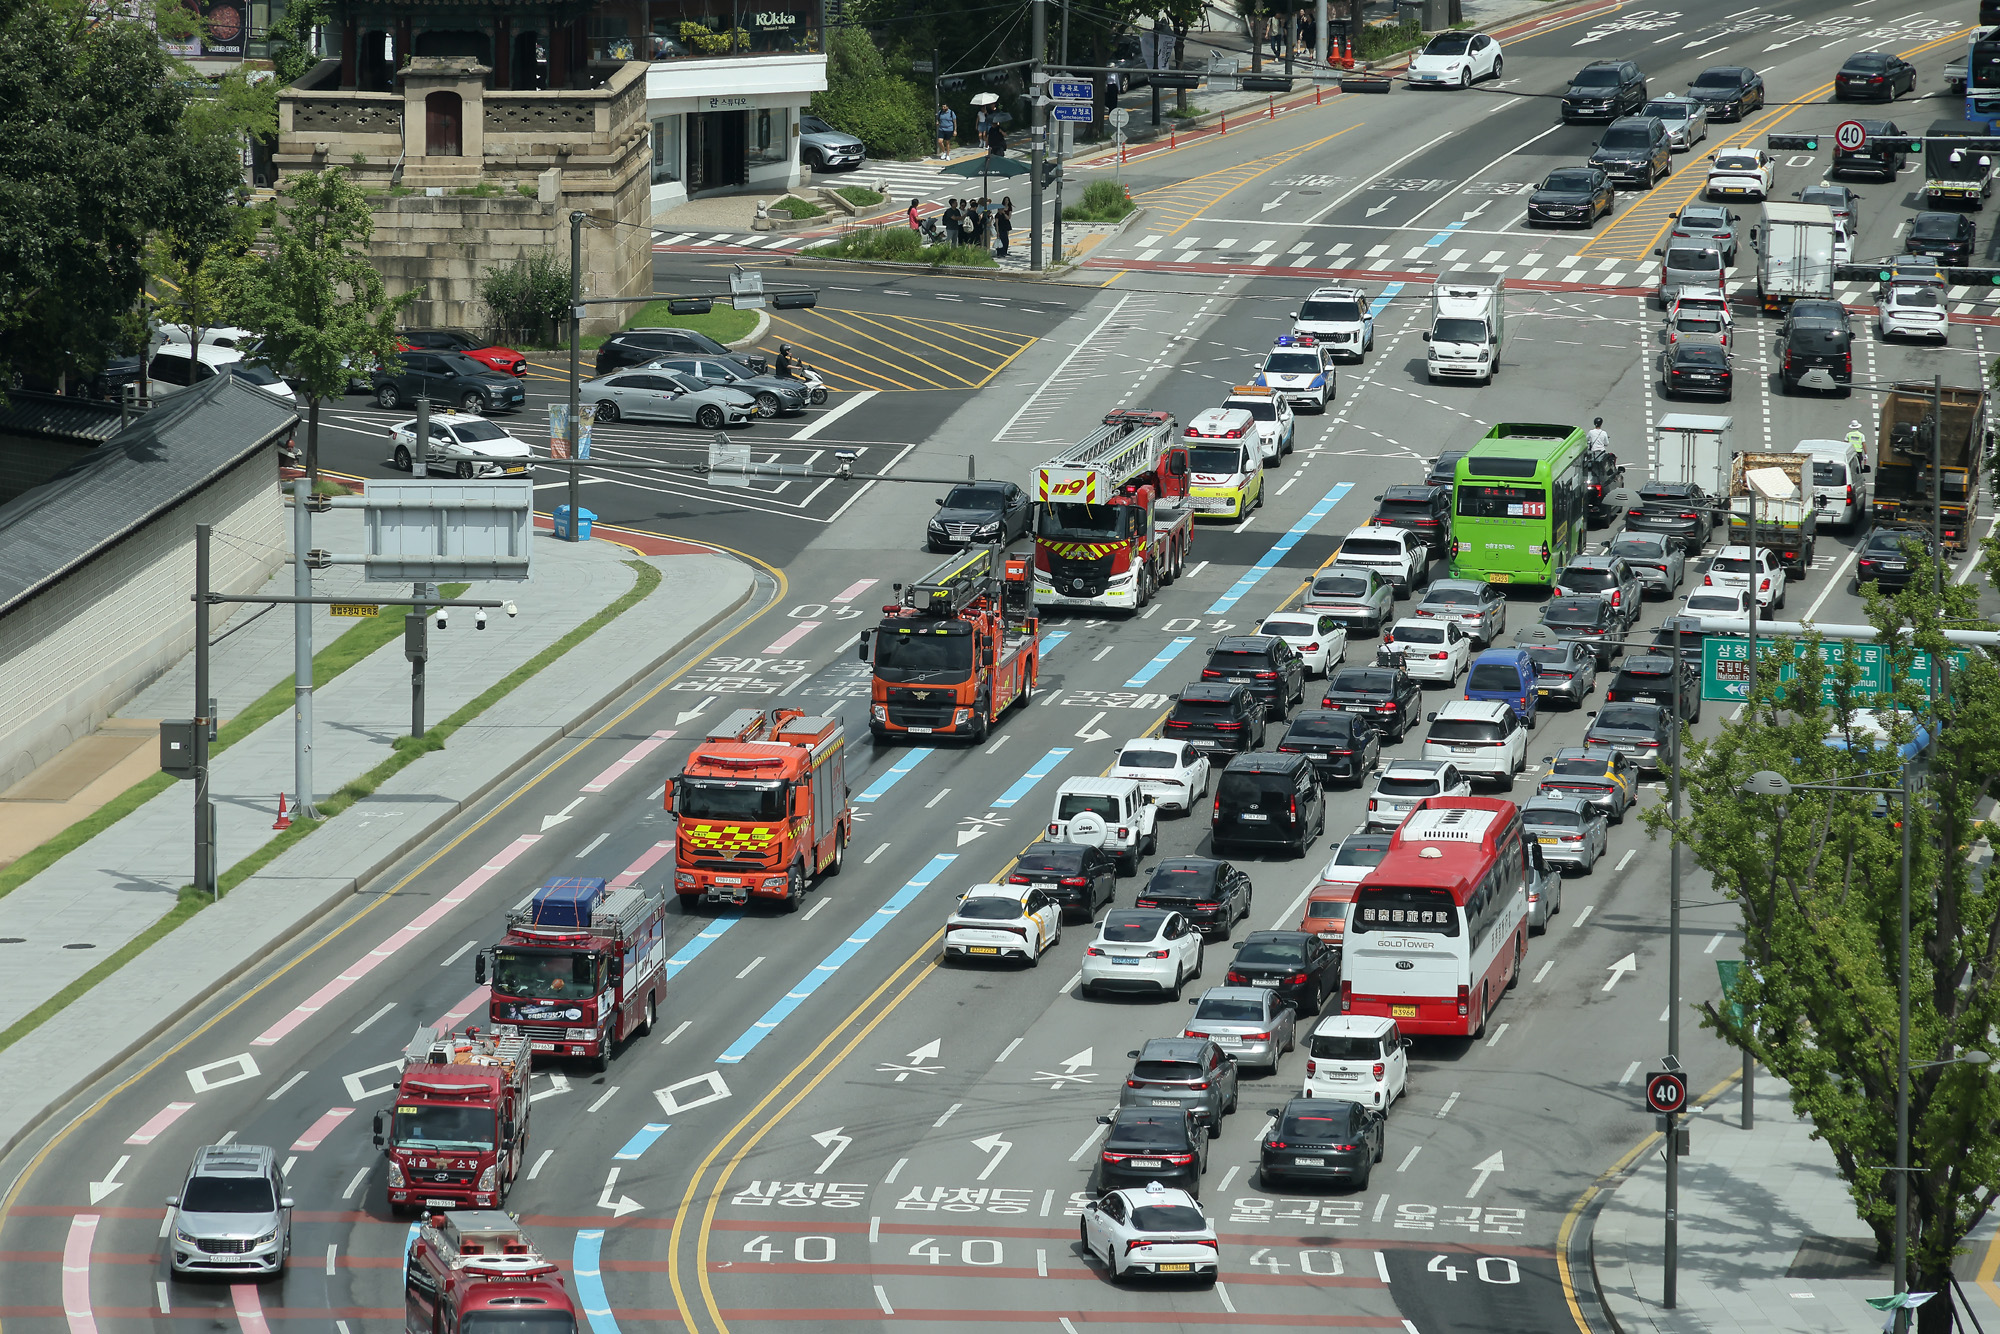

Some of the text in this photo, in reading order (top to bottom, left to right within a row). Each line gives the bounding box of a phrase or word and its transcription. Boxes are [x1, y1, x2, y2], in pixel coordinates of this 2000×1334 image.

[1060, 84, 1080, 92] 율곡로
[710, 97, 747, 106] 란 스튜디오
[1072, 107, 1092, 116] 삼청로
[1841, 126, 1860, 144] 40
[1051, 479, 1087, 496] 119
[1530, 502, 1545, 515] 11
[933, 590, 949, 598] 119
[786, 604, 864, 621] 40
[1160, 618, 1237, 634] 40
[1718, 672, 1741, 680] National
[1059, 690, 1169, 710] 세종로
[1398, 1008, 1415, 1017] 3966
[1655, 1084, 1677, 1103] 40
[406, 1156, 479, 1169] 서울 소방
[730, 1180, 869, 1208] 삼청동
[894, 1186, 1034, 1214] 삼청동
[1229, 1197, 1364, 1226] 율곡로
[1393, 1203, 1527, 1235] 율곡로
[742, 1235, 837, 1263] 40
[907, 1237, 1004, 1266] 40
[1249, 1248, 1345, 1277] 40
[1427, 1254, 1521, 1285] 40
